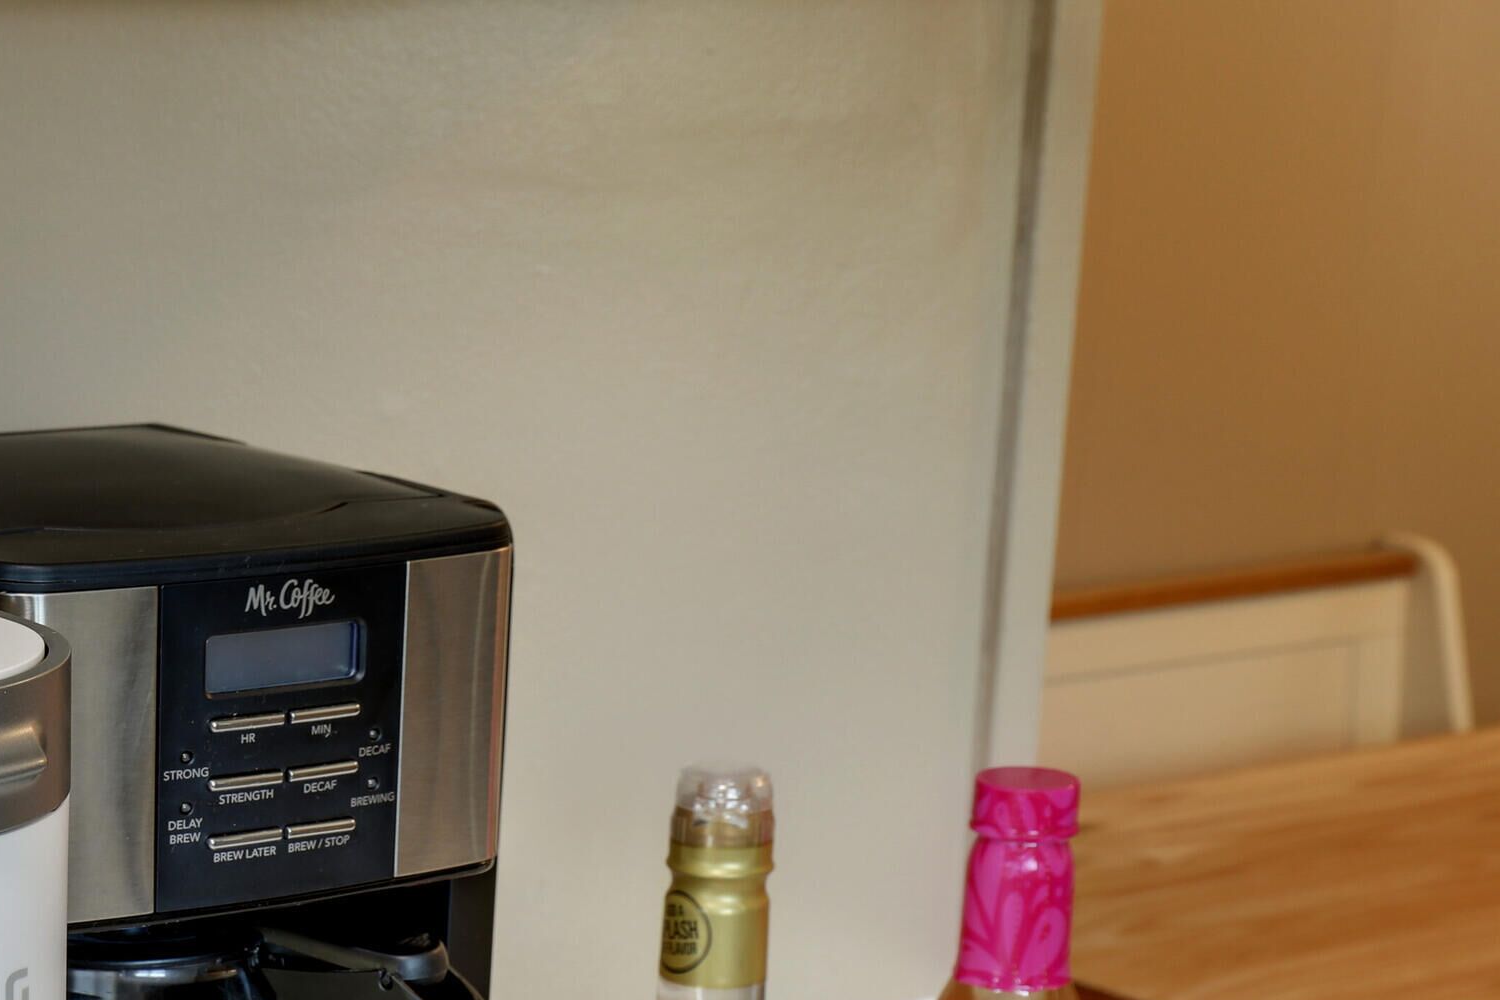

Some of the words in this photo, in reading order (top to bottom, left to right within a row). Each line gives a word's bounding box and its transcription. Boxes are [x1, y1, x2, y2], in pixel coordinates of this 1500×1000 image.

[244, 583, 277, 617] Mr.
[279, 578, 336, 619] Coffee
[311, 724, 332, 736] MIN
[240, 732, 256, 744] HR
[358, 743, 392, 757] DECAF
[163, 767, 210, 782] STRONG
[303, 779, 338, 794] DECAF
[218, 789, 275, 805] STRENGTH
[350, 791, 396, 808] BREWING
[168, 818, 204, 831] DELAY
[169, 831, 201, 845] BREW
[288, 839, 317, 853] BREW
[324, 834, 351, 848] STOP
[213, 850, 244, 863] BREW
[245, 846, 277, 860] LATER
